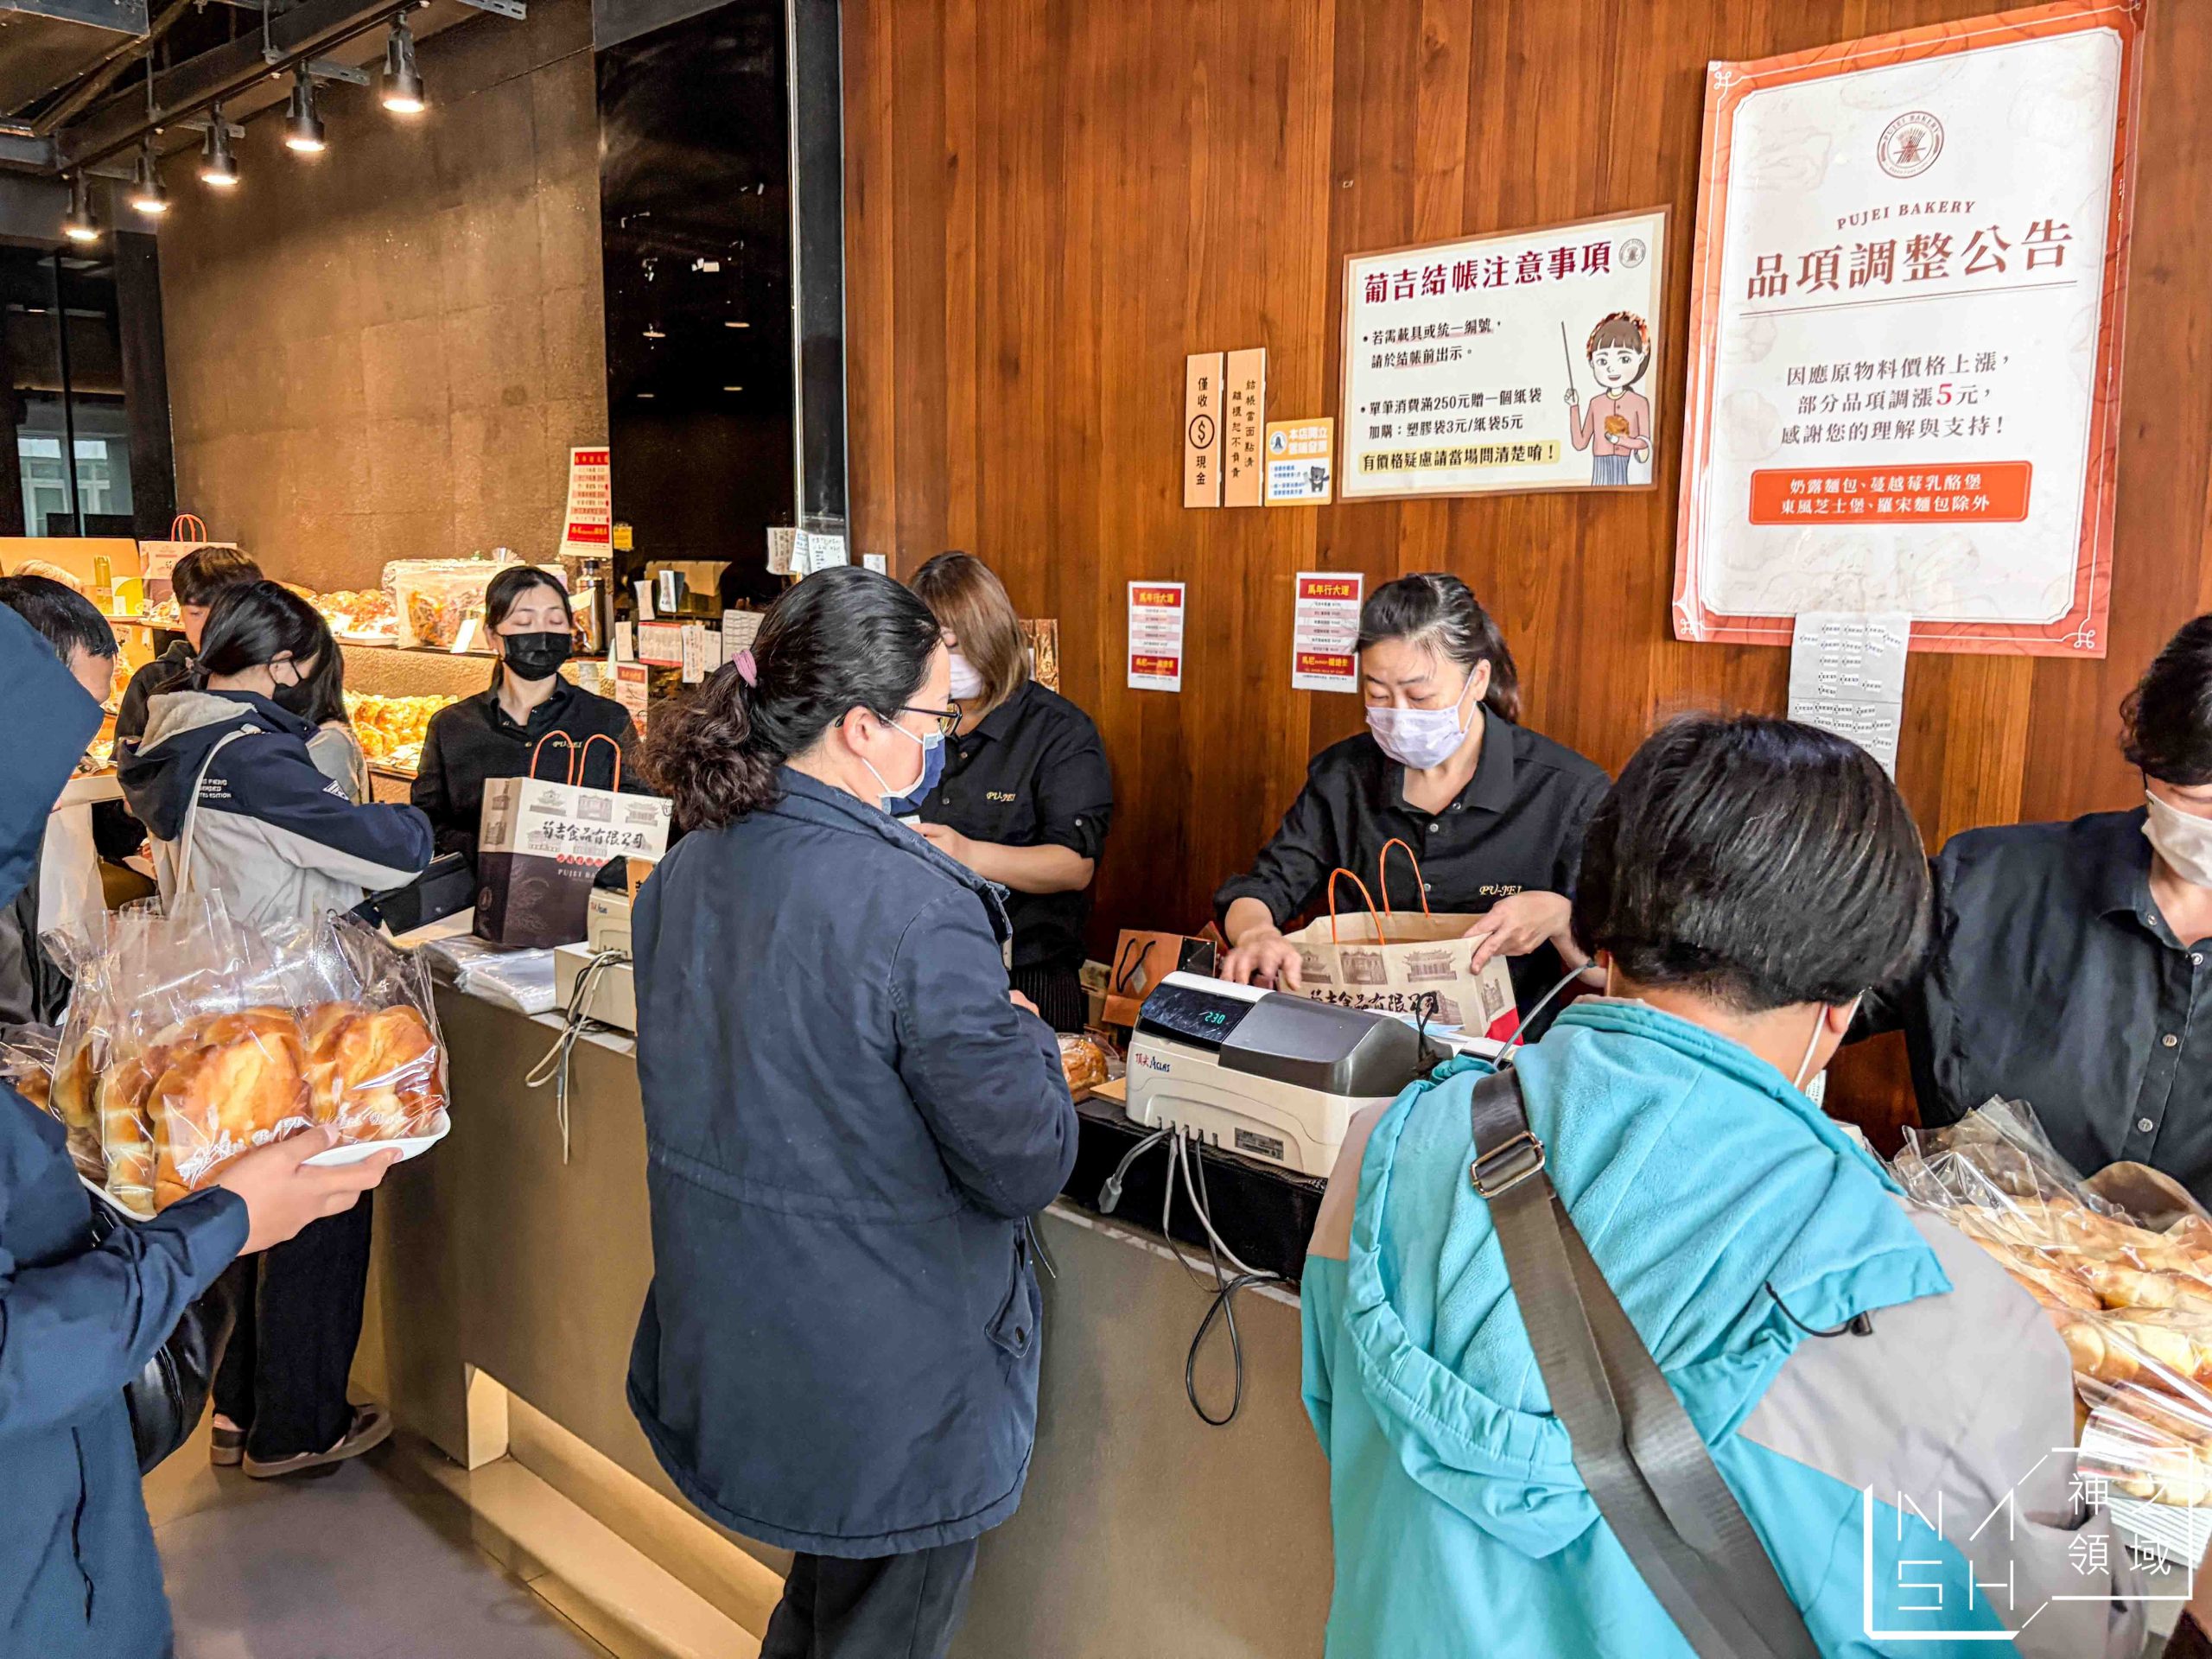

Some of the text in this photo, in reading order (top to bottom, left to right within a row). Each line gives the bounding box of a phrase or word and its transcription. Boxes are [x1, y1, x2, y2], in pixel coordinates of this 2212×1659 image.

[1837, 200, 1976, 231] PUJEI BAKERY
[1363, 240, 1612, 304] 葡吉結帳注意事項
[1747, 218, 2074, 301] 品項調整公告
[1198, 377, 1208, 407] 僅收
[1196, 455, 1207, 486] 現金
[1205, 1011, 1226, 1025] 230
